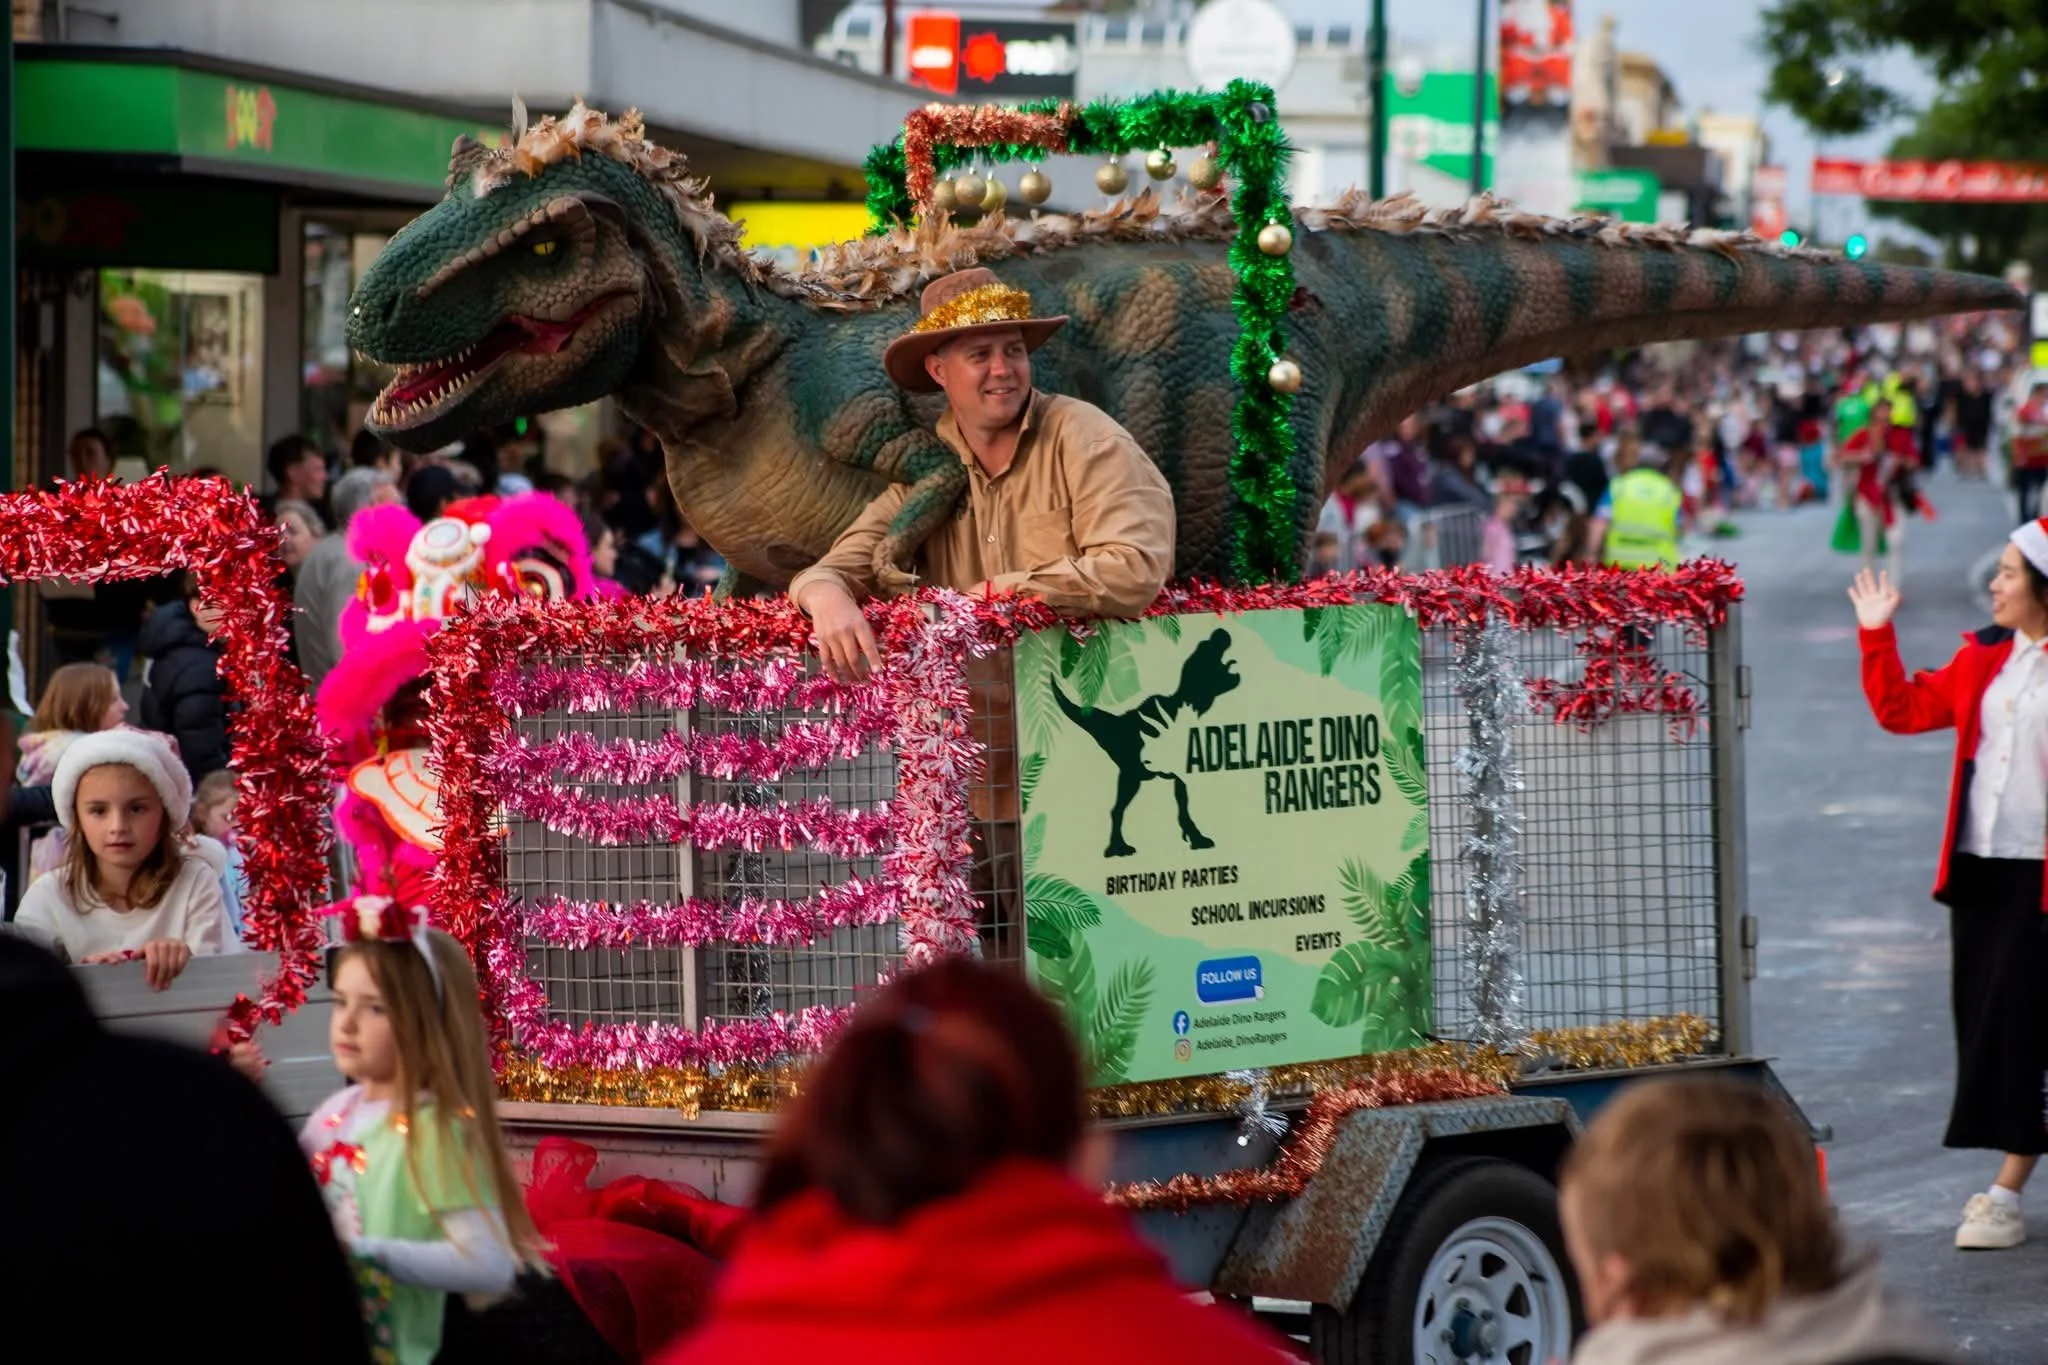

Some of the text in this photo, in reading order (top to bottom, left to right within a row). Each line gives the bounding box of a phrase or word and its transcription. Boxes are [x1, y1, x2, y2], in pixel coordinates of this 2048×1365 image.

[1187, 714, 1379, 773] ADELAIDE DINO
[1265, 763, 1381, 813] RANGERS
[1107, 865, 1239, 895] BIRTHDAY PARTIES
[1191, 895, 1325, 926] SCHOOL INCURSIONS
[1296, 931, 1341, 951] EVENTS
[1202, 968, 1258, 985] FOLLOW US
[1194, 1010, 1287, 1029] Adelaide Dino Rangers
[1197, 1032, 1288, 1050] Adelaide_DinoRangers
